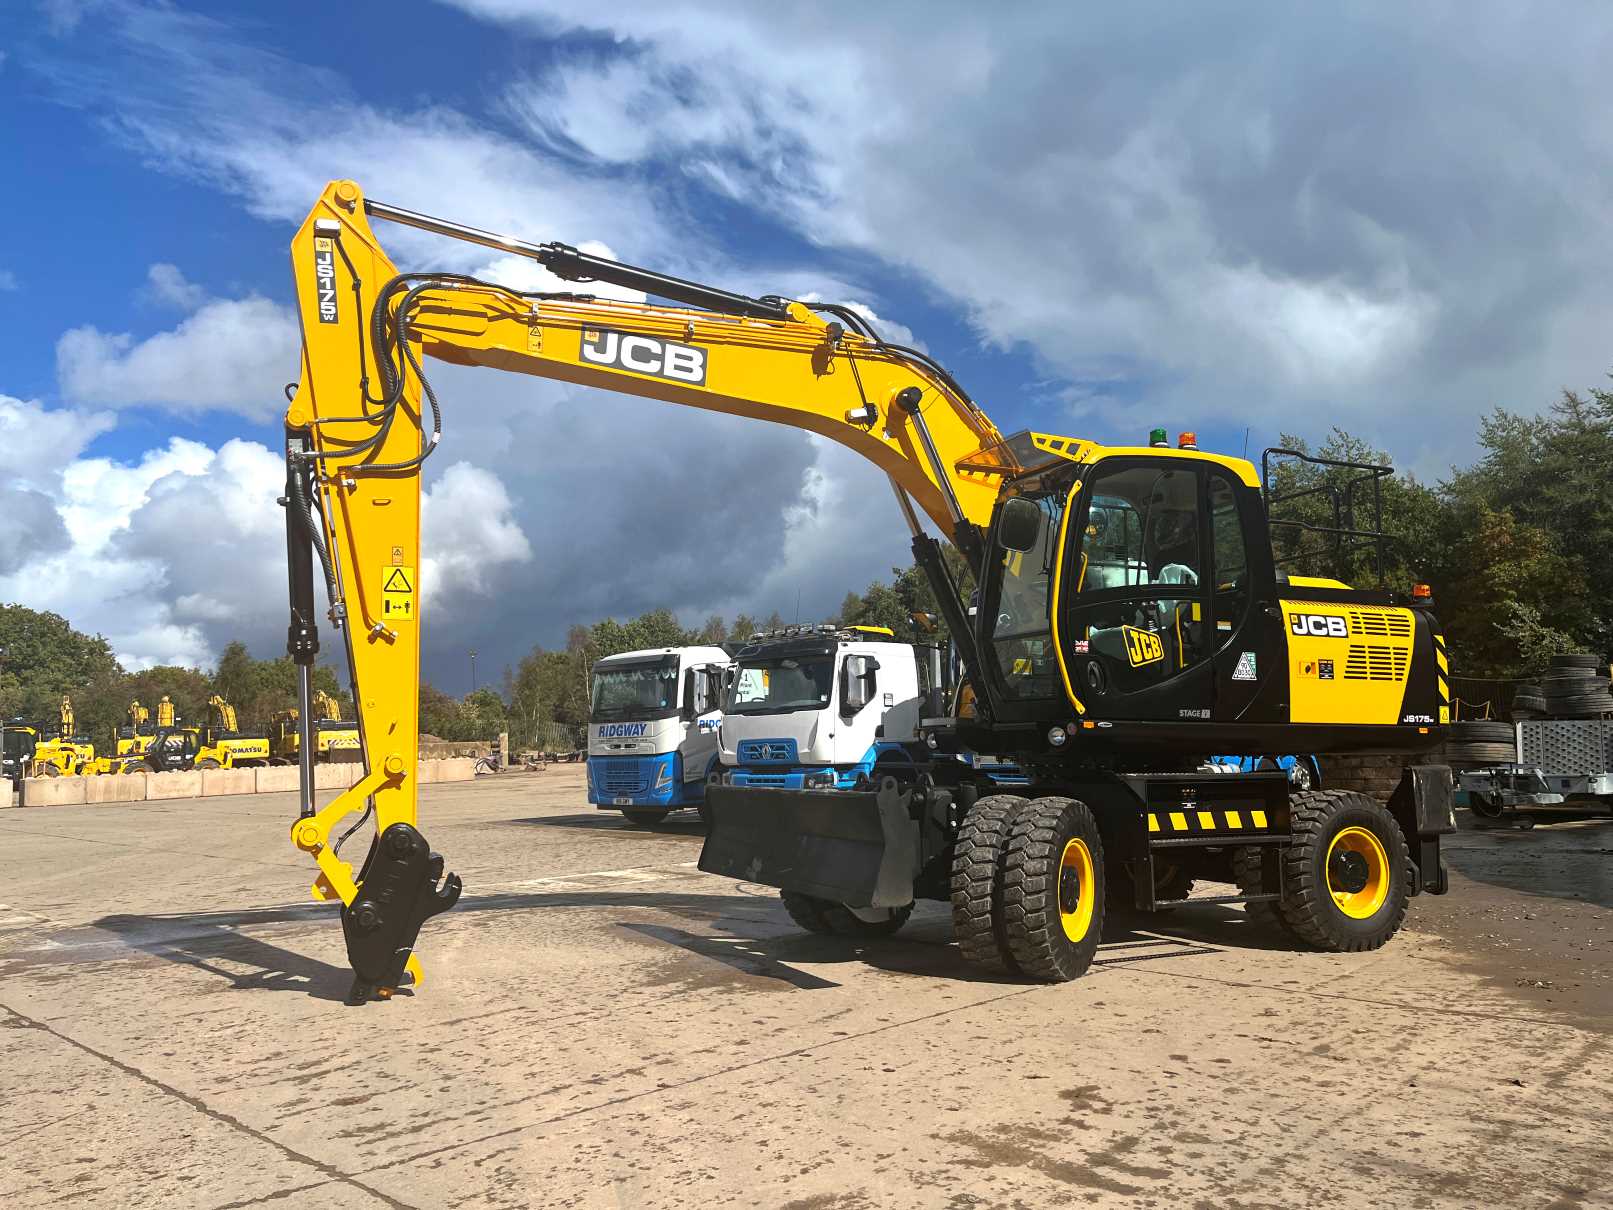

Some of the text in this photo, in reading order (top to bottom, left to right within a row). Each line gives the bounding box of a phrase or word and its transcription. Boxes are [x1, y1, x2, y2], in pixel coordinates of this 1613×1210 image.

[583, 332, 704, 382] JCB
[1292, 614, 1347, 637] JCB
[1129, 629, 1162, 663] JCB
[1179, 709, 1201, 717] STAGE
[598, 723, 647, 737] RIDGWAY
[229, 746, 262, 754] OMATSU
